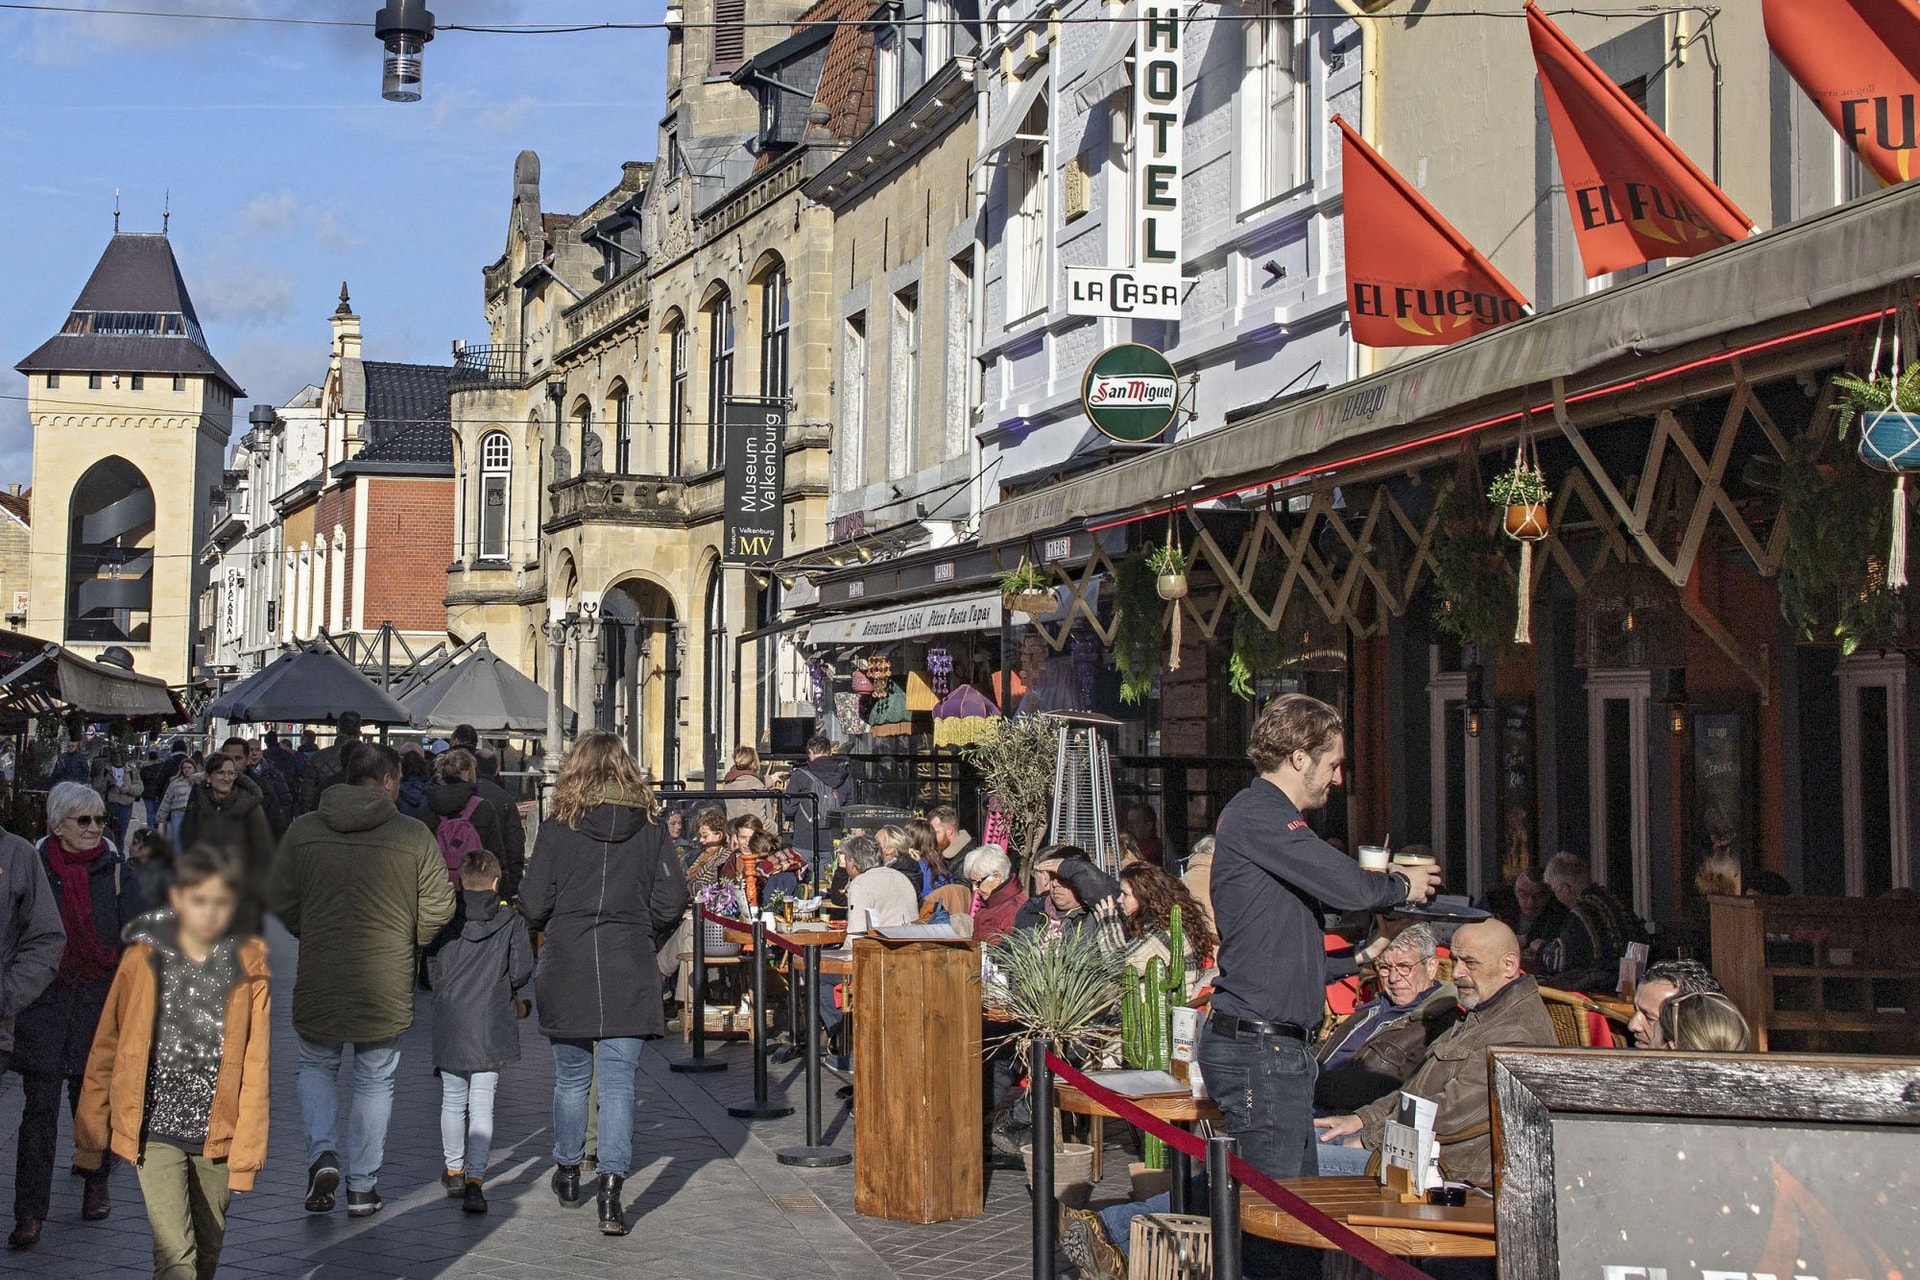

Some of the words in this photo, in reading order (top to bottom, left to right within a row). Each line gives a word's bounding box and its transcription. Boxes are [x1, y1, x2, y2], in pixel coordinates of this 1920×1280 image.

[1143, 7, 1178, 264] HOTEL
[1073, 280, 1103, 302] LA
[1109, 273, 1178, 312] CASA
[1353, 283, 1389, 317] EL
[741, 437, 758, 512] Museum
[760, 413, 781, 512] Valkenburg
[739, 526, 775, 536] Valkenburg
[739, 536, 774, 556] MV
[226, 568, 235, 635] COPACABANA
[928, 610, 947, 627] Pizza
[947, 607, 967, 625] Pasta
[968, 604, 991, 626] Tapas
